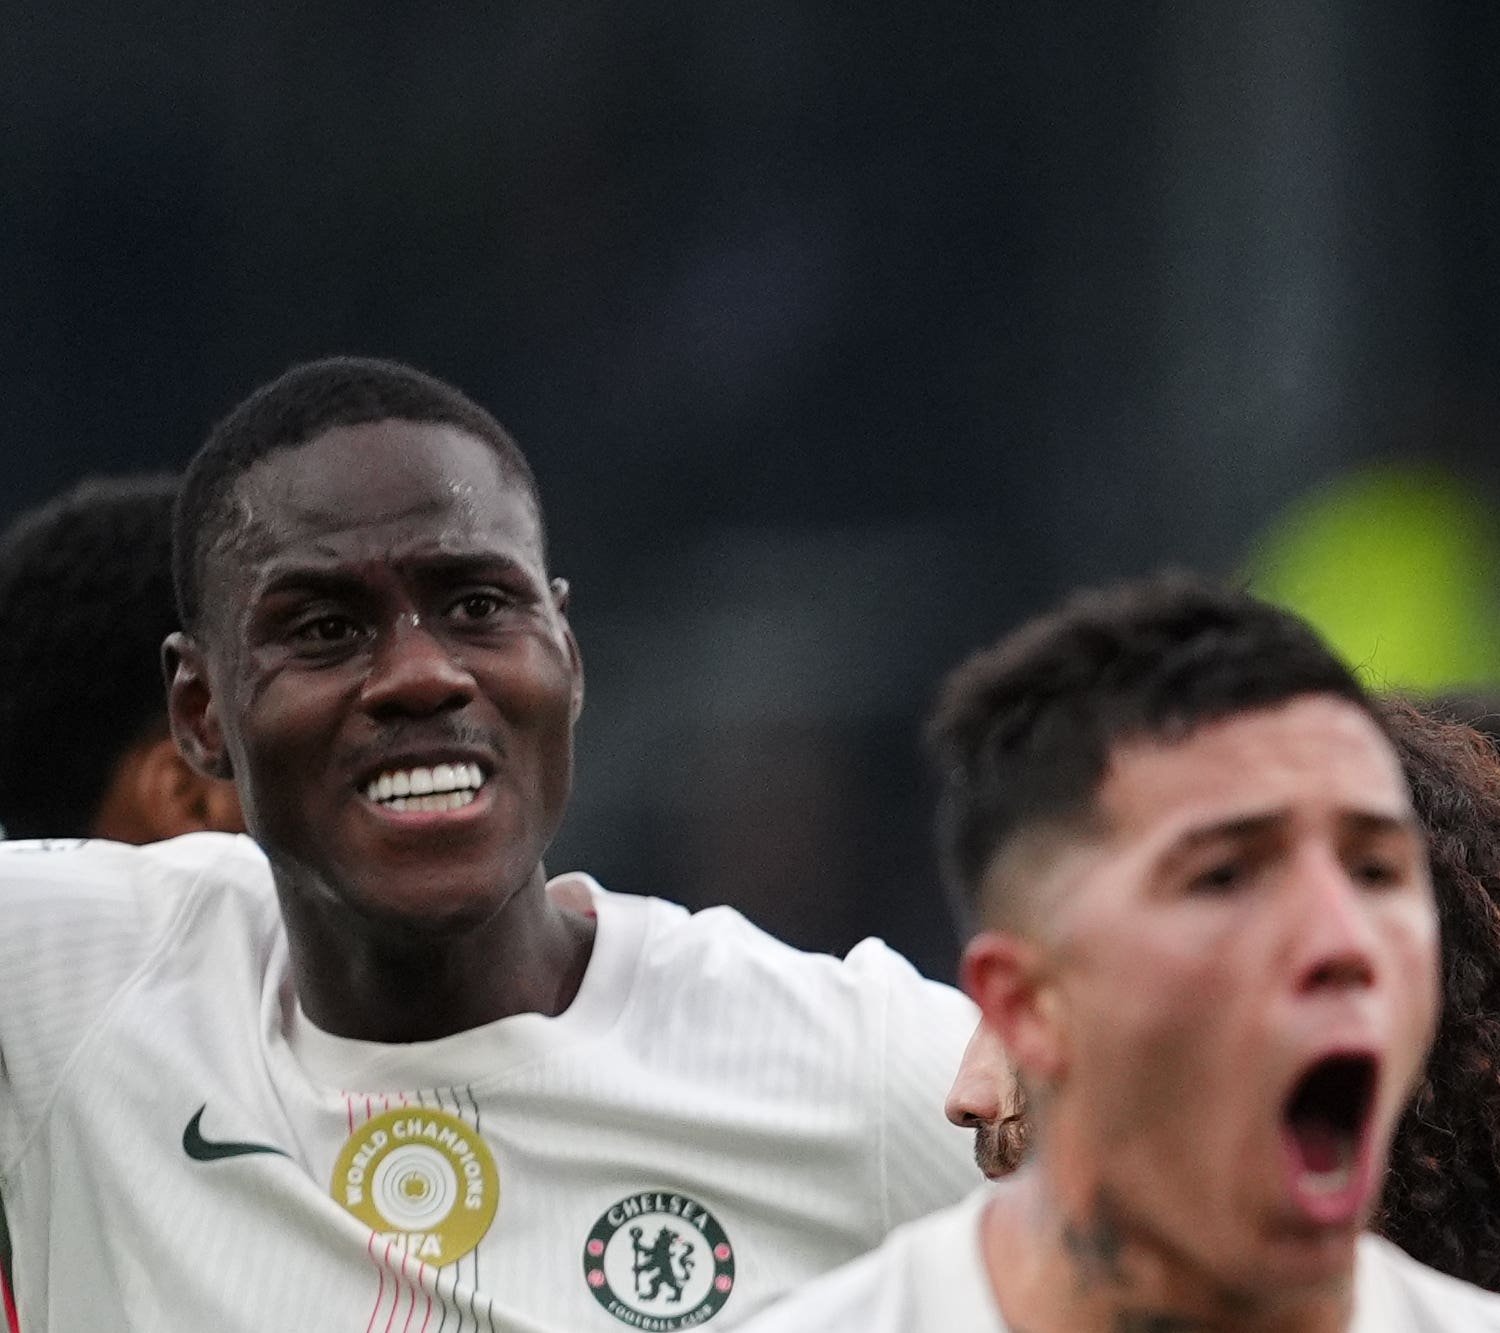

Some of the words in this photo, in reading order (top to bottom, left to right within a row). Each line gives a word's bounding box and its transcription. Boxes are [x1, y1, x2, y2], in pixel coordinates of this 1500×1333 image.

[345, 1129, 388, 1206] WORLD
[391, 1117, 484, 1211] CHAMPIONS
[607, 1193, 708, 1231] CHELSEA
[608, 1300, 676, 1332] FOOTBALL
[680, 1303, 713, 1327] CLUB
